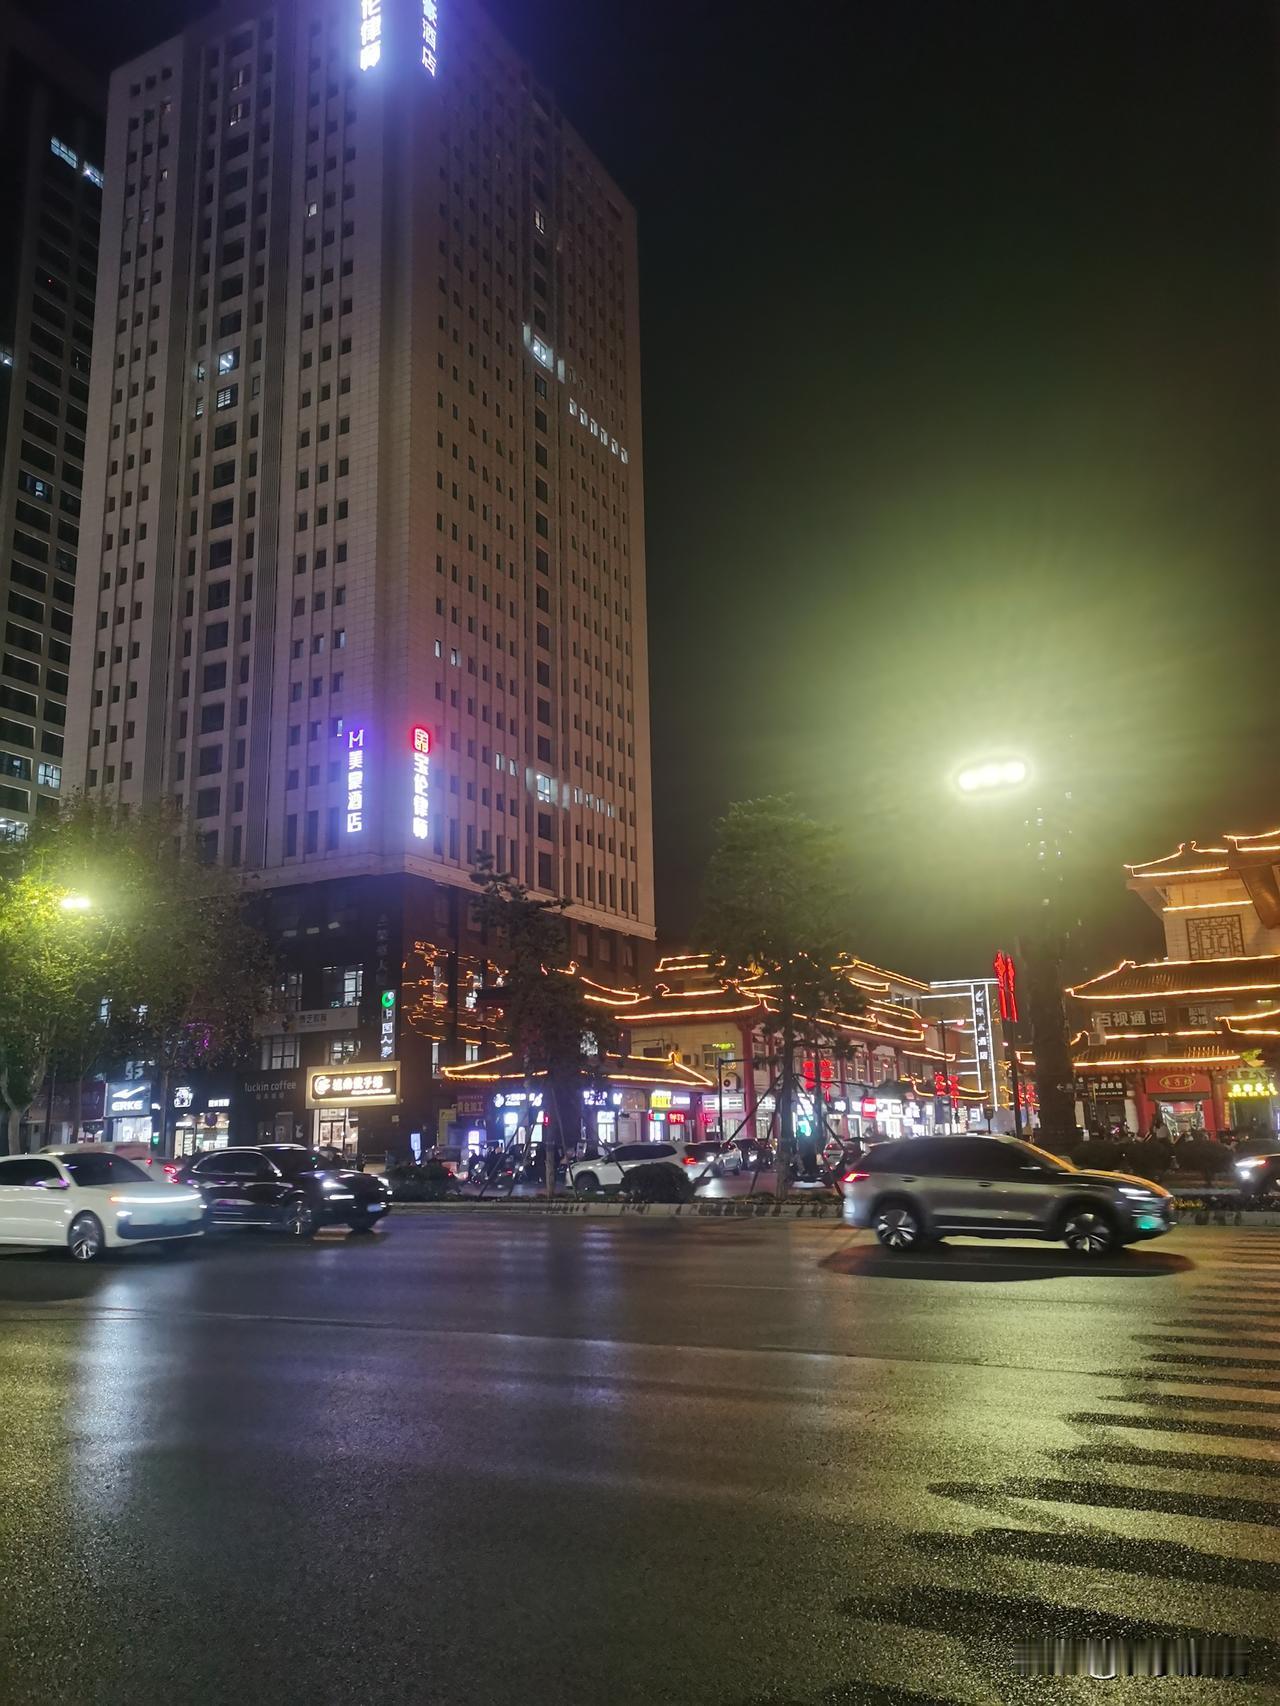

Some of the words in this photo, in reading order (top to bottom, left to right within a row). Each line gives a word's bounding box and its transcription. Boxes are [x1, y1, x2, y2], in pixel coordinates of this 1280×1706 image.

[244, 1081, 269, 1092] luckin
[270, 1079, 297, 1090] coffee
[111, 1100, 143, 1111] ERKE
